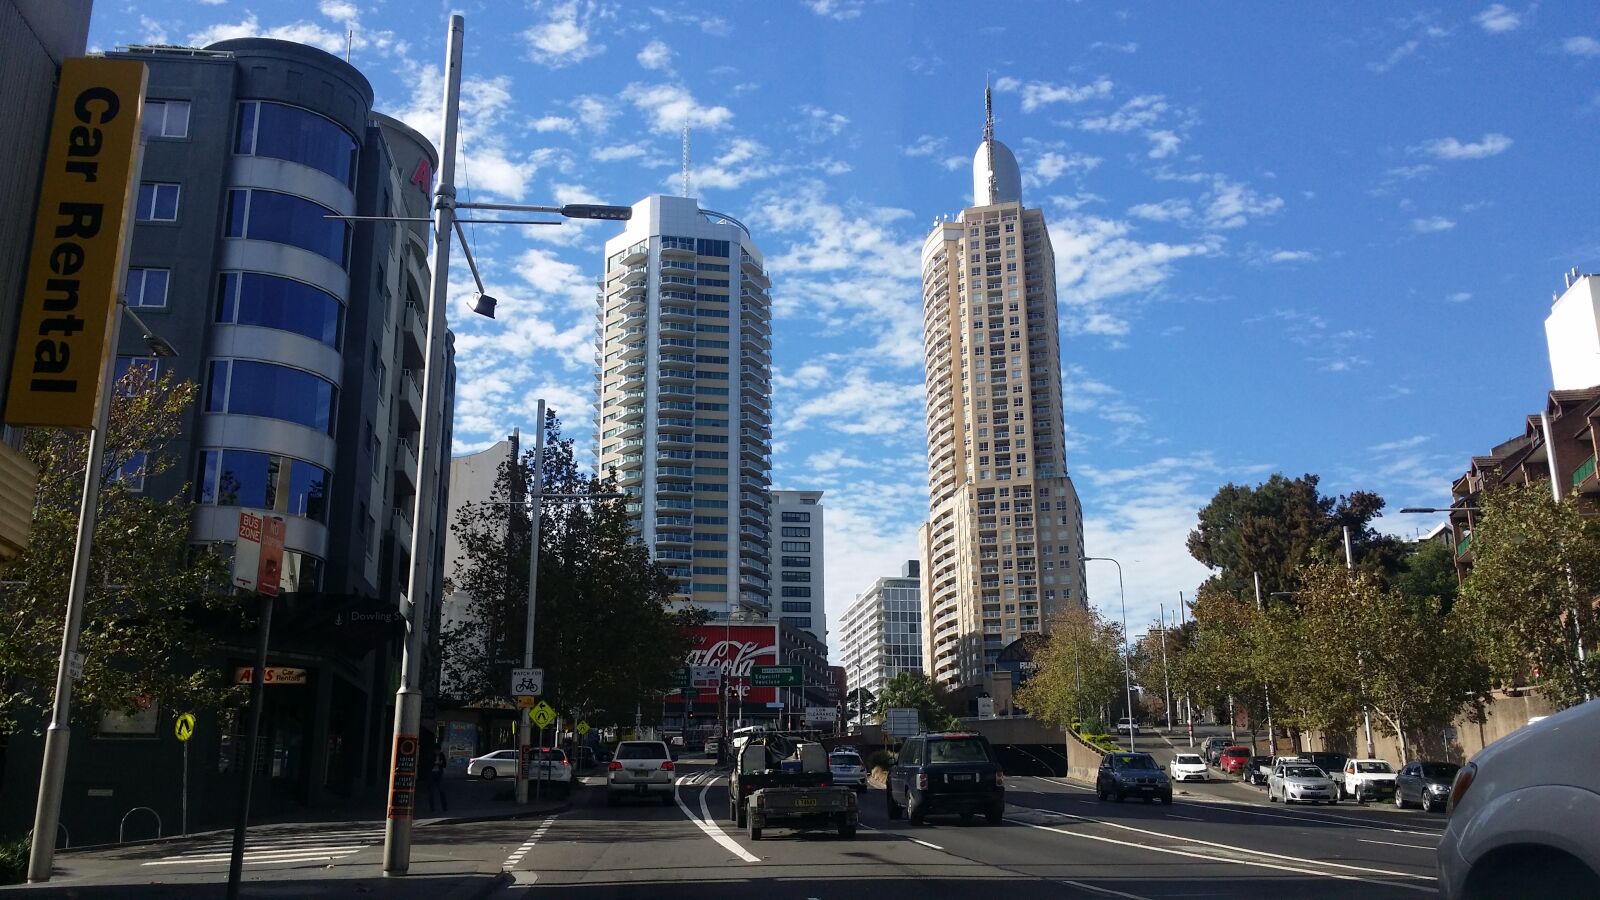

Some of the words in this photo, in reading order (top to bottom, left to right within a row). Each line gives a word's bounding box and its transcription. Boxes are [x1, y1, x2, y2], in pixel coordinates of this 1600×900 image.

[65, 86, 120, 183] Car
[30, 202, 105, 393] Rental
[243, 515, 259, 529] BUS
[240, 525, 261, 542] ZONE
[351, 610, 392, 623] Dowling
